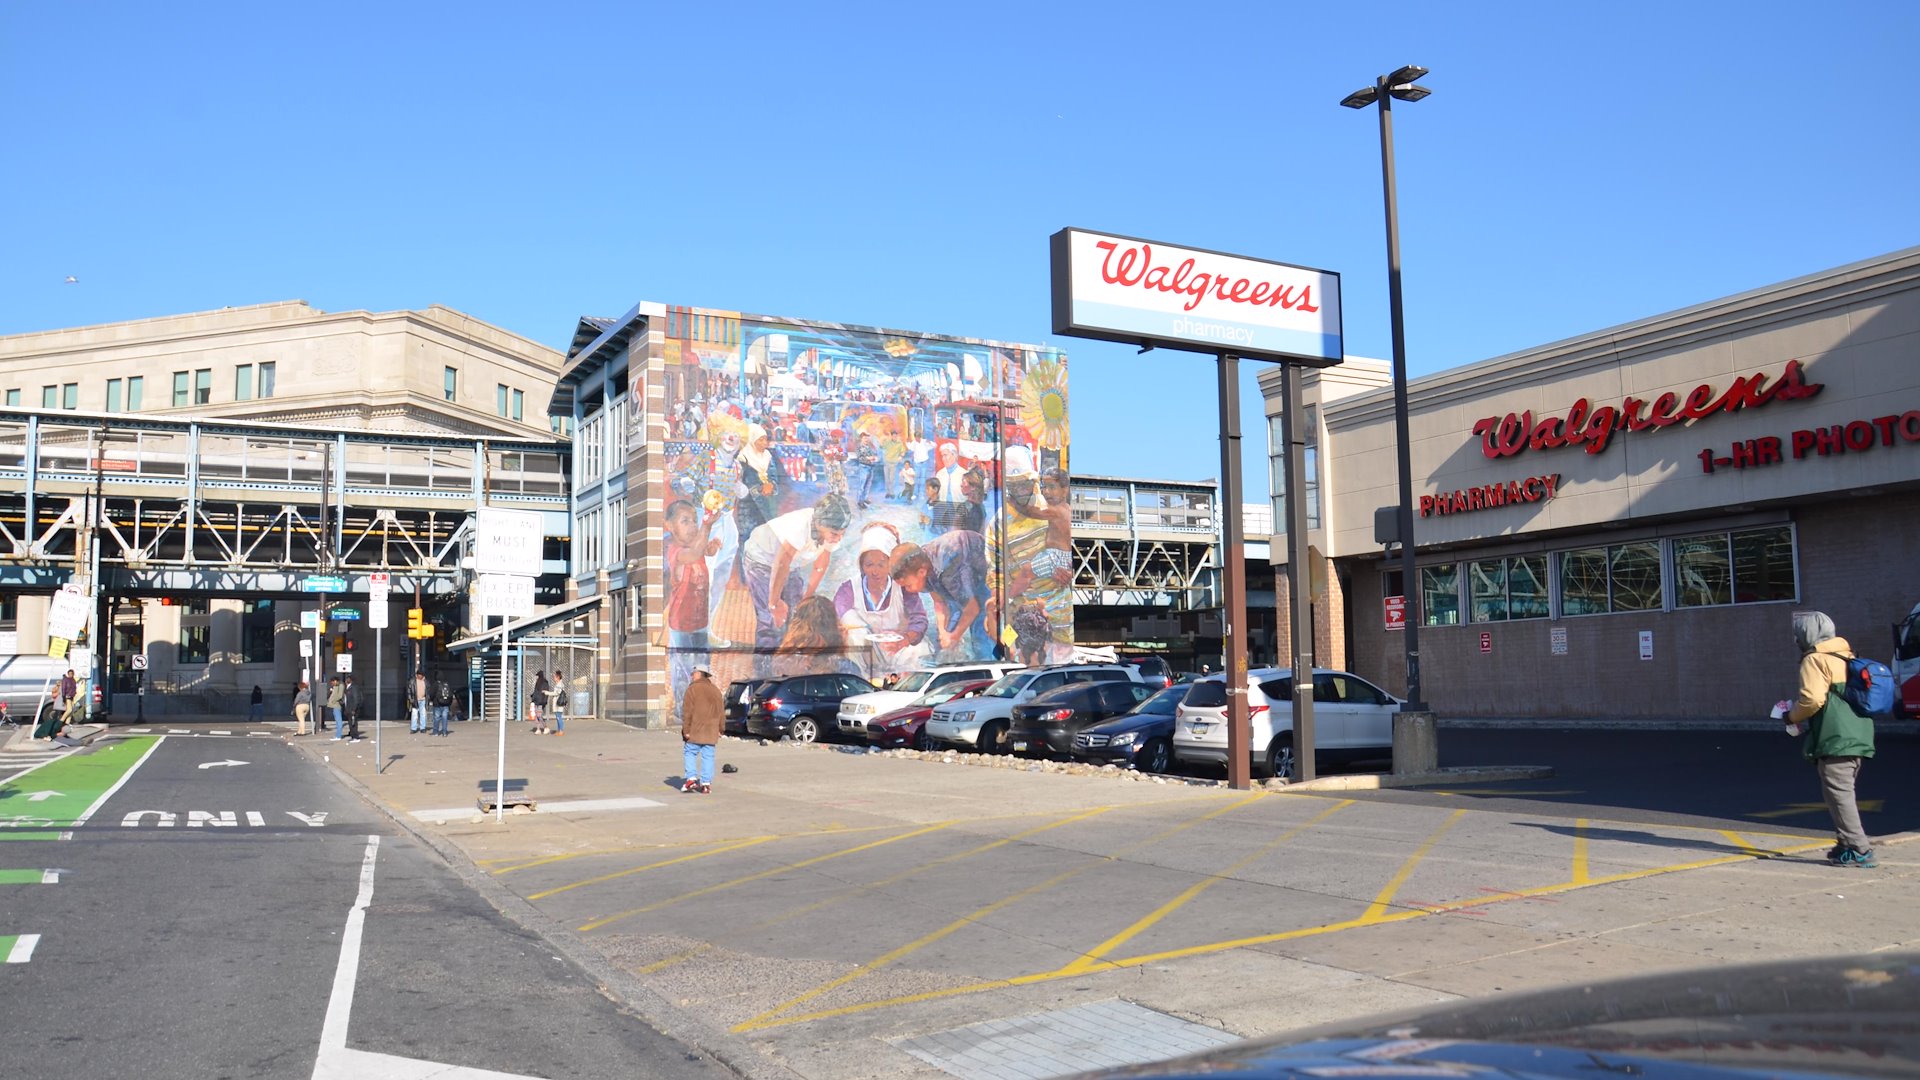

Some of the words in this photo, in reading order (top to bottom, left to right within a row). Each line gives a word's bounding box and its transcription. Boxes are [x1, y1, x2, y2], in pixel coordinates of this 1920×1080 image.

[1096, 240, 1319, 312] Walgreens
[1173, 316, 1255, 345] pharmacy
[1472, 359, 1825, 459] Walgreens
[1697, 436, 1782, 474] 1-HR
[1792, 410, 1920, 460] PHOTO
[1419, 473, 1560, 518] PHARMACY
[492, 535, 527, 548] MUST
[486, 597, 527, 610] BUSES
